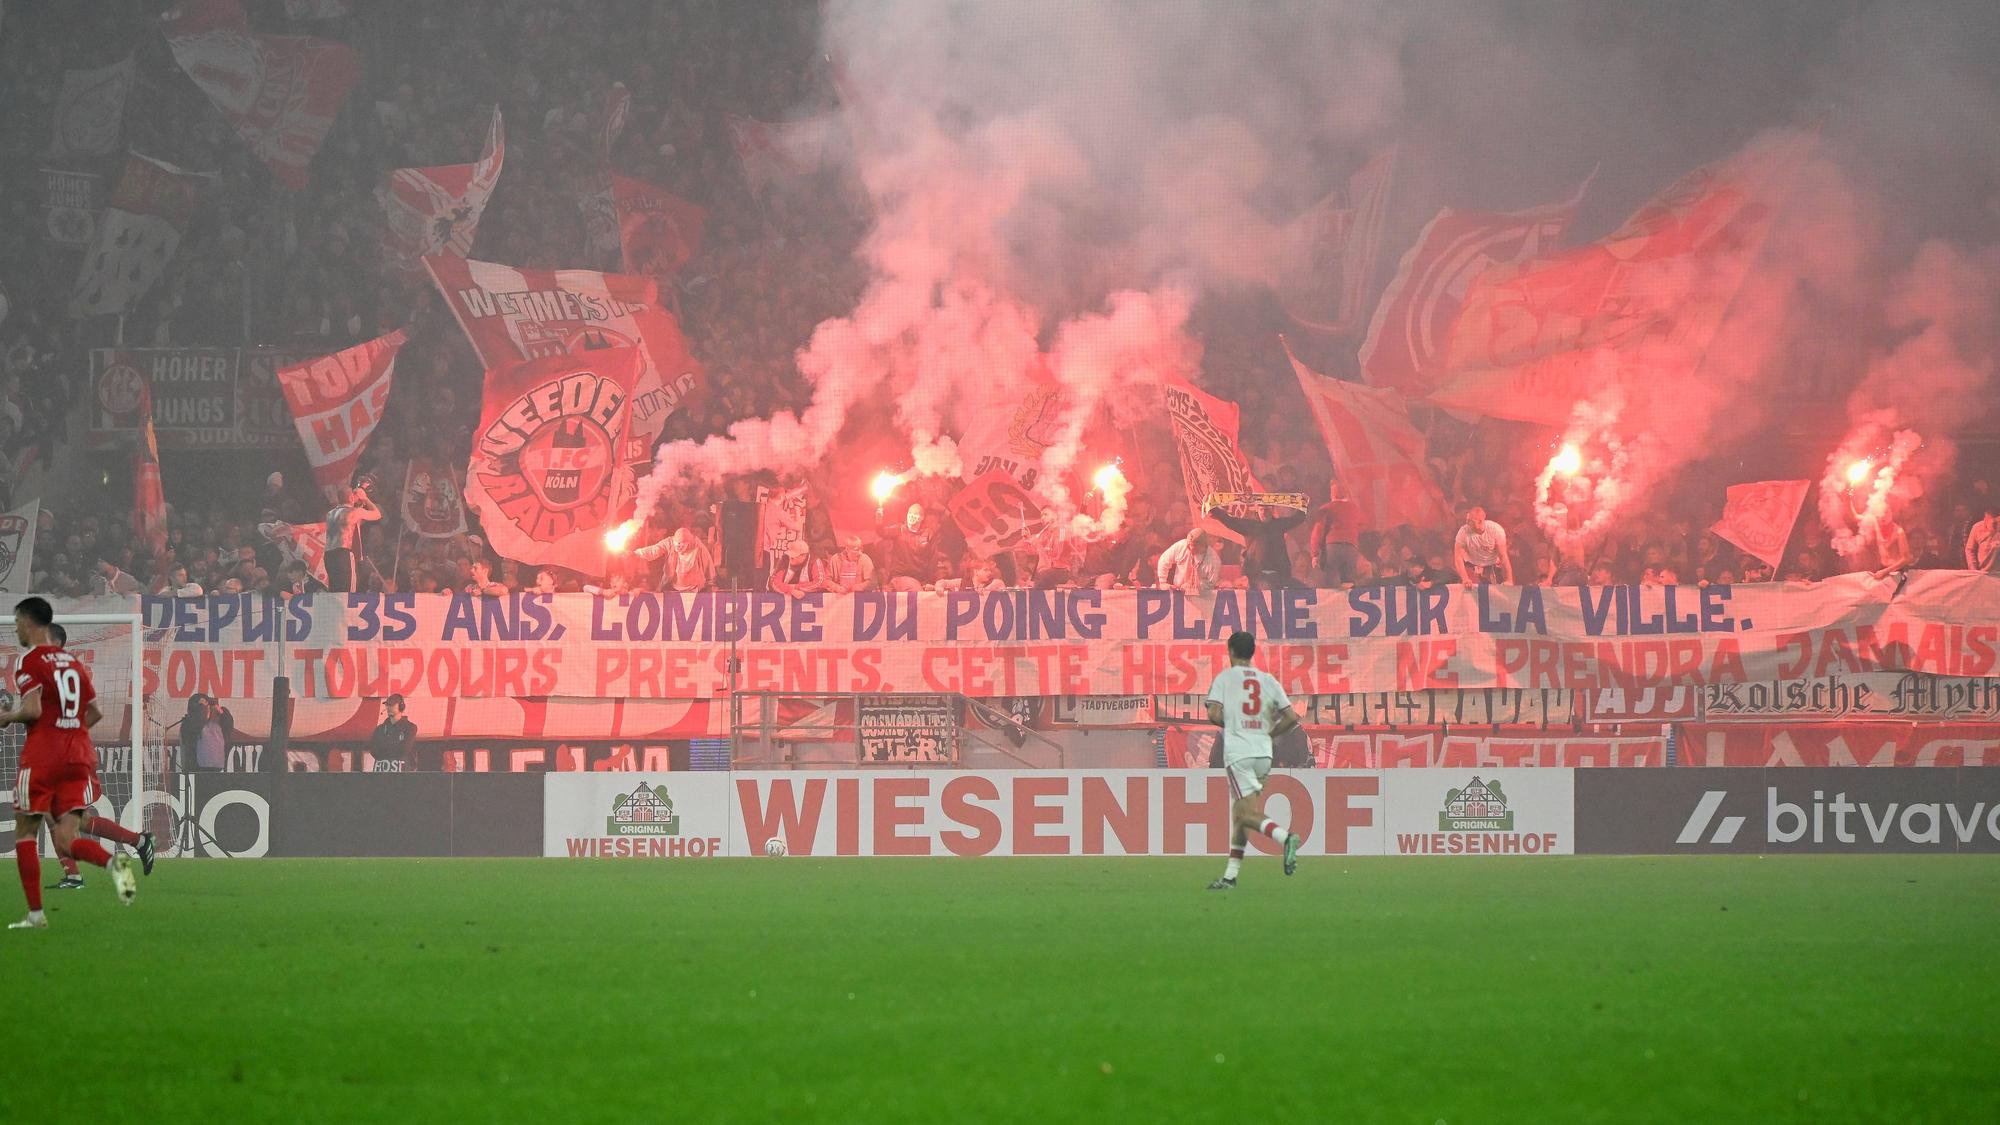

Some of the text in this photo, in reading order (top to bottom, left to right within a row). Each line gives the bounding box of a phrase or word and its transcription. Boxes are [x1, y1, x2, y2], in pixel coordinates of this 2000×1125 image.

[152, 353, 226, 382] HÖHER
[152, 398, 225, 423] JUNGS
[544, 472, 578, 490] KÖLN
[141, 583, 1754, 642] DEPUIS 35 ANS, L'OMBRE DU POING PLANE SUR LA VILLE.
[130, 650, 265, 698] SONT
[293, 648, 563, 698] TOUJOURS
[921, 645, 1090, 696] CETTE
[1122, 644, 1349, 695] HISTIRE
[1396, 639, 1459, 692] NE
[1495, 638, 1748, 689] PRENDRA
[1775, 622, 1998, 679] JAMAIS
[54, 668, 80, 719] 19
[1242, 679, 1261, 716] 3
[619, 825, 666, 834] ORIGINAL
[736, 777, 1380, 857] WIESENHOF
[1452, 820, 1500, 830] ORIGINAL
[566, 837, 721, 858] WIESENHOF
[1397, 833, 1558, 853] WIESENHOF
